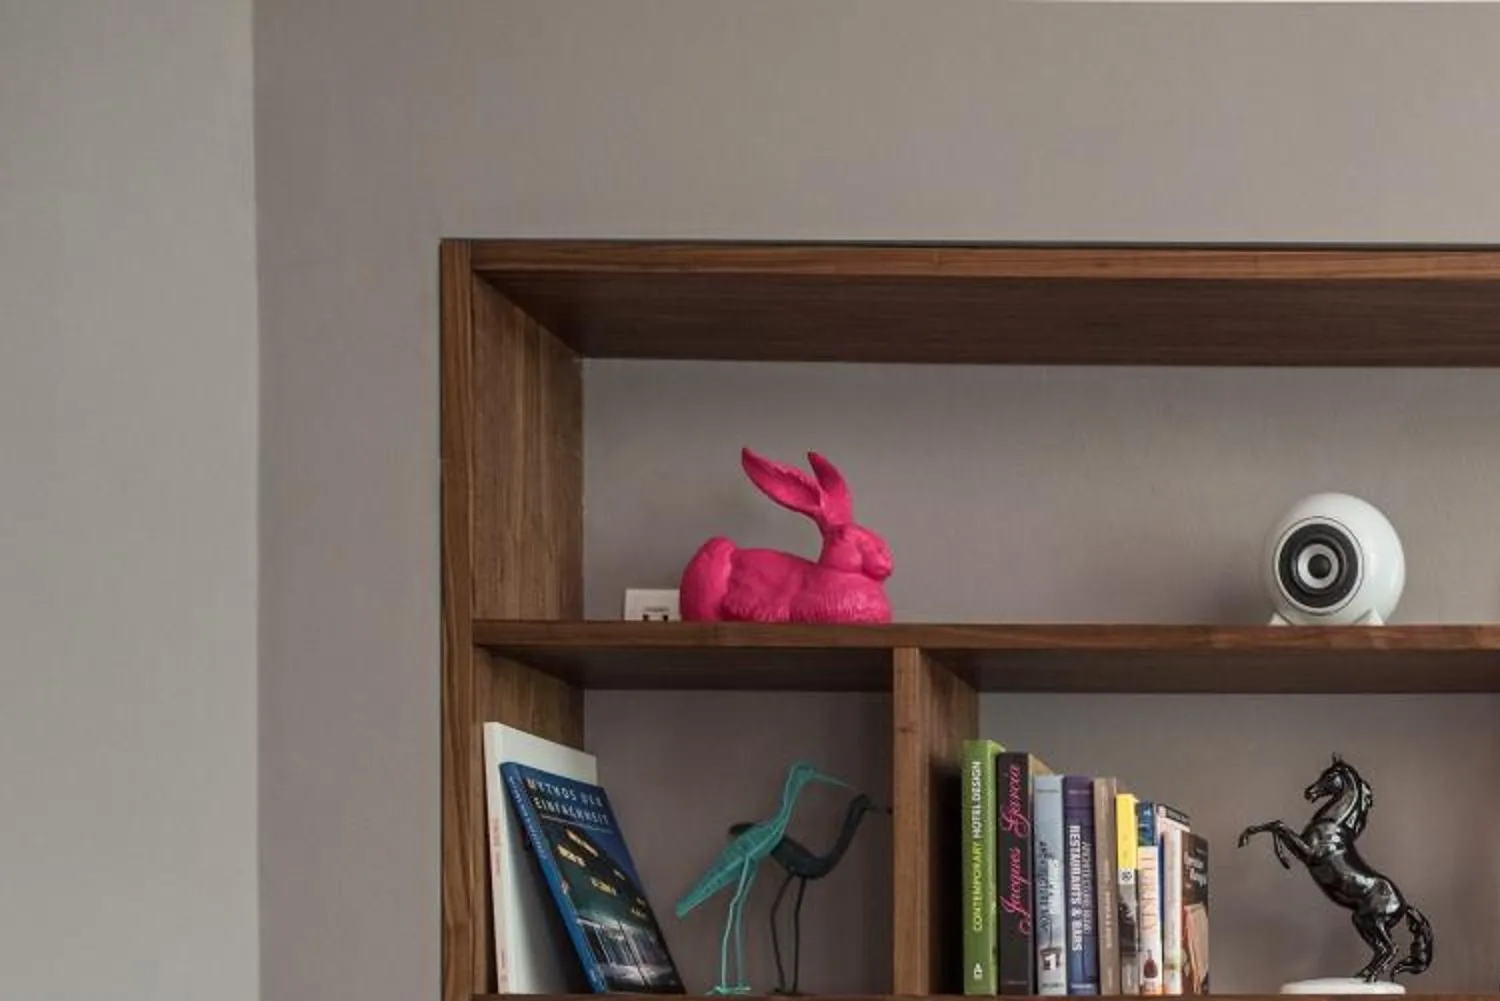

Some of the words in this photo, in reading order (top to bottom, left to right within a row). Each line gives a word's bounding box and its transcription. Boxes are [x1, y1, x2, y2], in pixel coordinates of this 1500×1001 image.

[970, 761, 982, 803] DESIGN
[971, 805, 983, 839] HOTEL
[1069, 824, 1082, 904] RESTAURANTS
[971, 841, 984, 932] CONTEMPORARY
[1072, 919, 1083, 951] BARS
